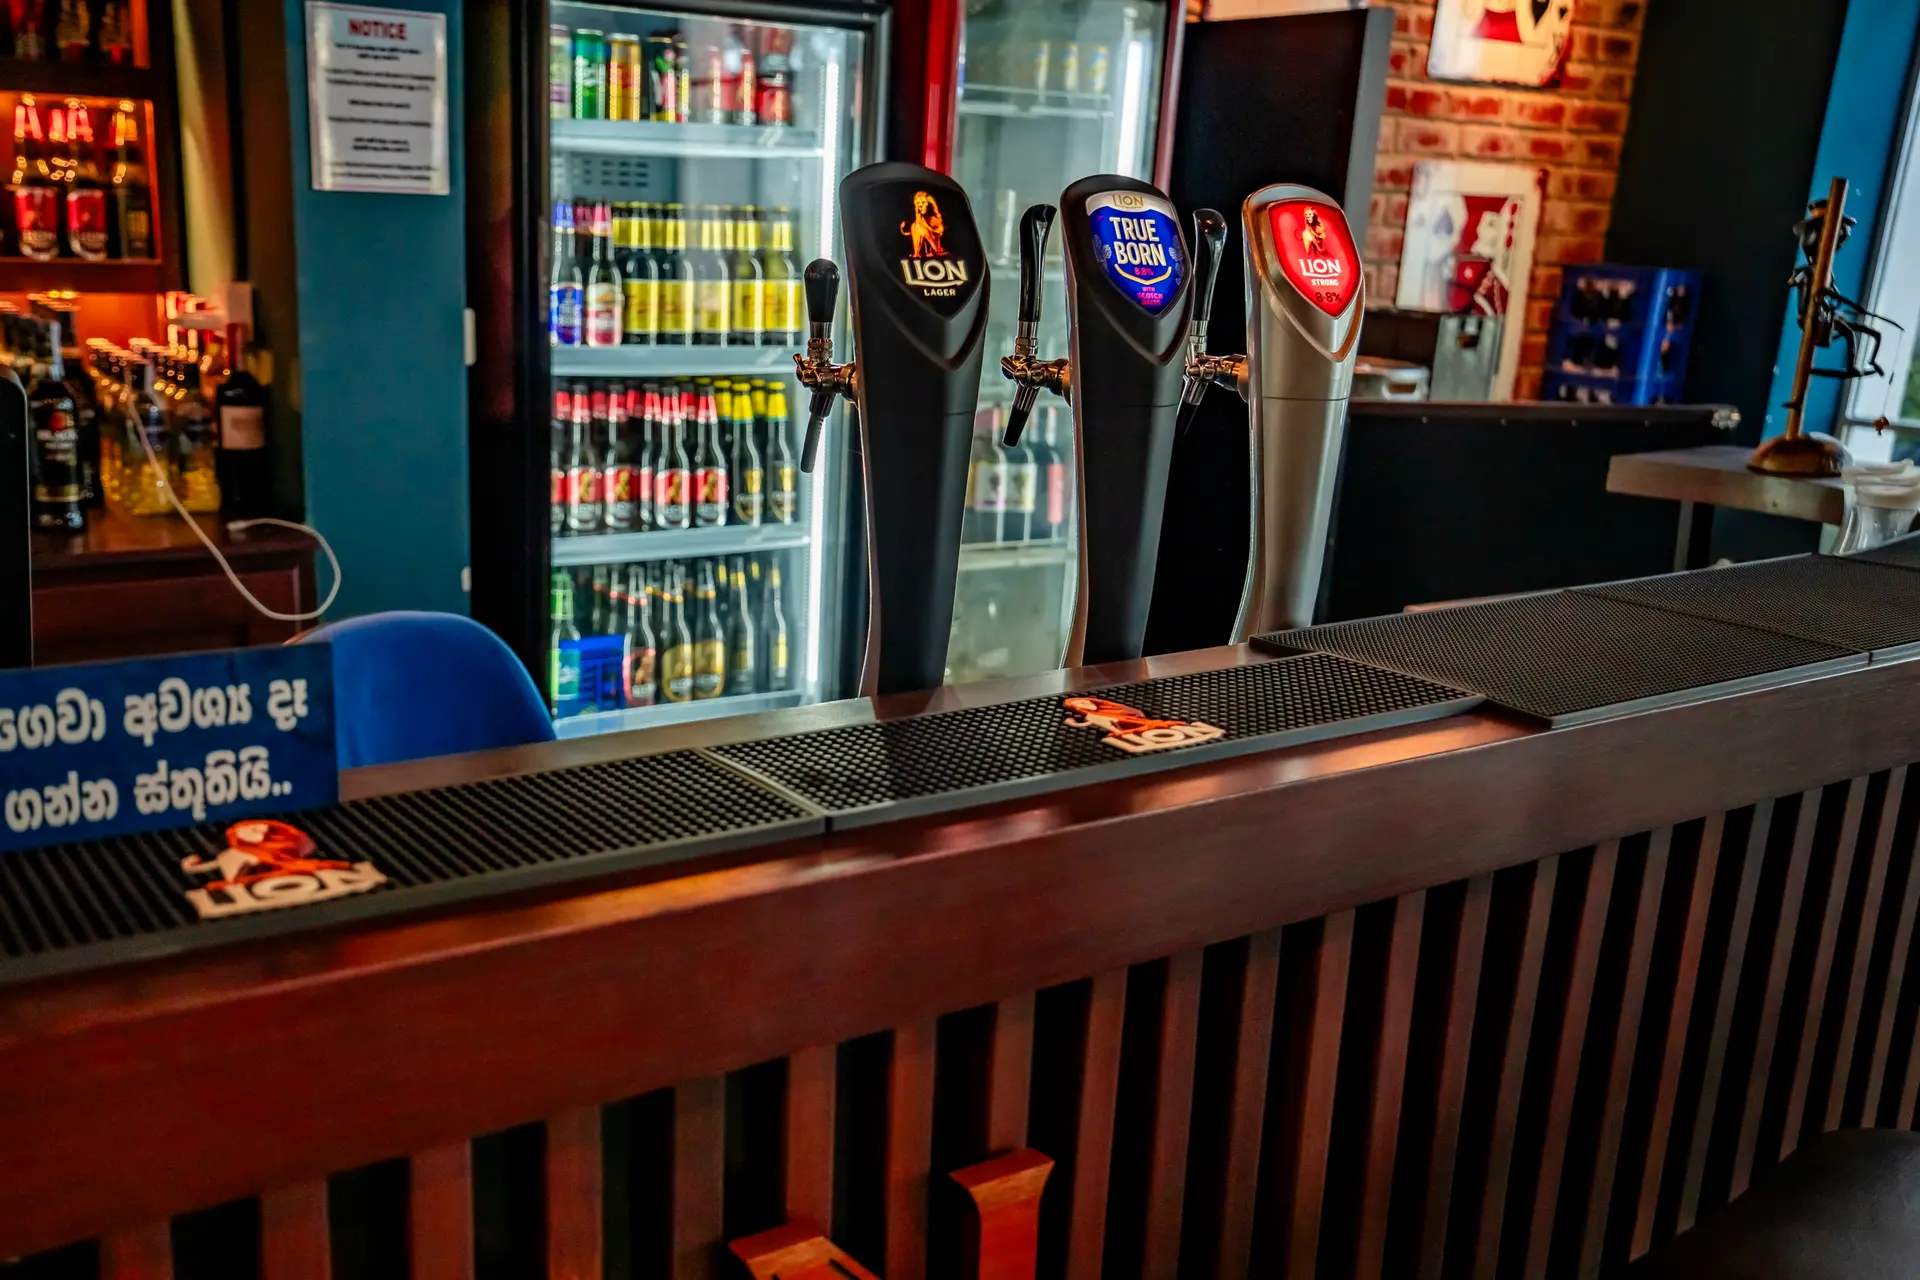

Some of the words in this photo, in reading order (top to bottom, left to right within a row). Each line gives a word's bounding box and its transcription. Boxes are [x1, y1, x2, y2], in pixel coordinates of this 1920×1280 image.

[348, 18, 407, 40] NOTICE
[1112, 194, 1144, 209] LION
[1109, 216, 1159, 242] TRUE
[1113, 241, 1167, 267] BORN
[901, 259, 968, 287] LION
[1299, 259, 1342, 278] LION
[923, 288, 957, 297] LAGER
[1312, 279, 1339, 287] STRONG
[1101, 721, 1226, 753] LION
[5, 770, 118, 833] ගන්න
[185, 861, 388, 918] LION
